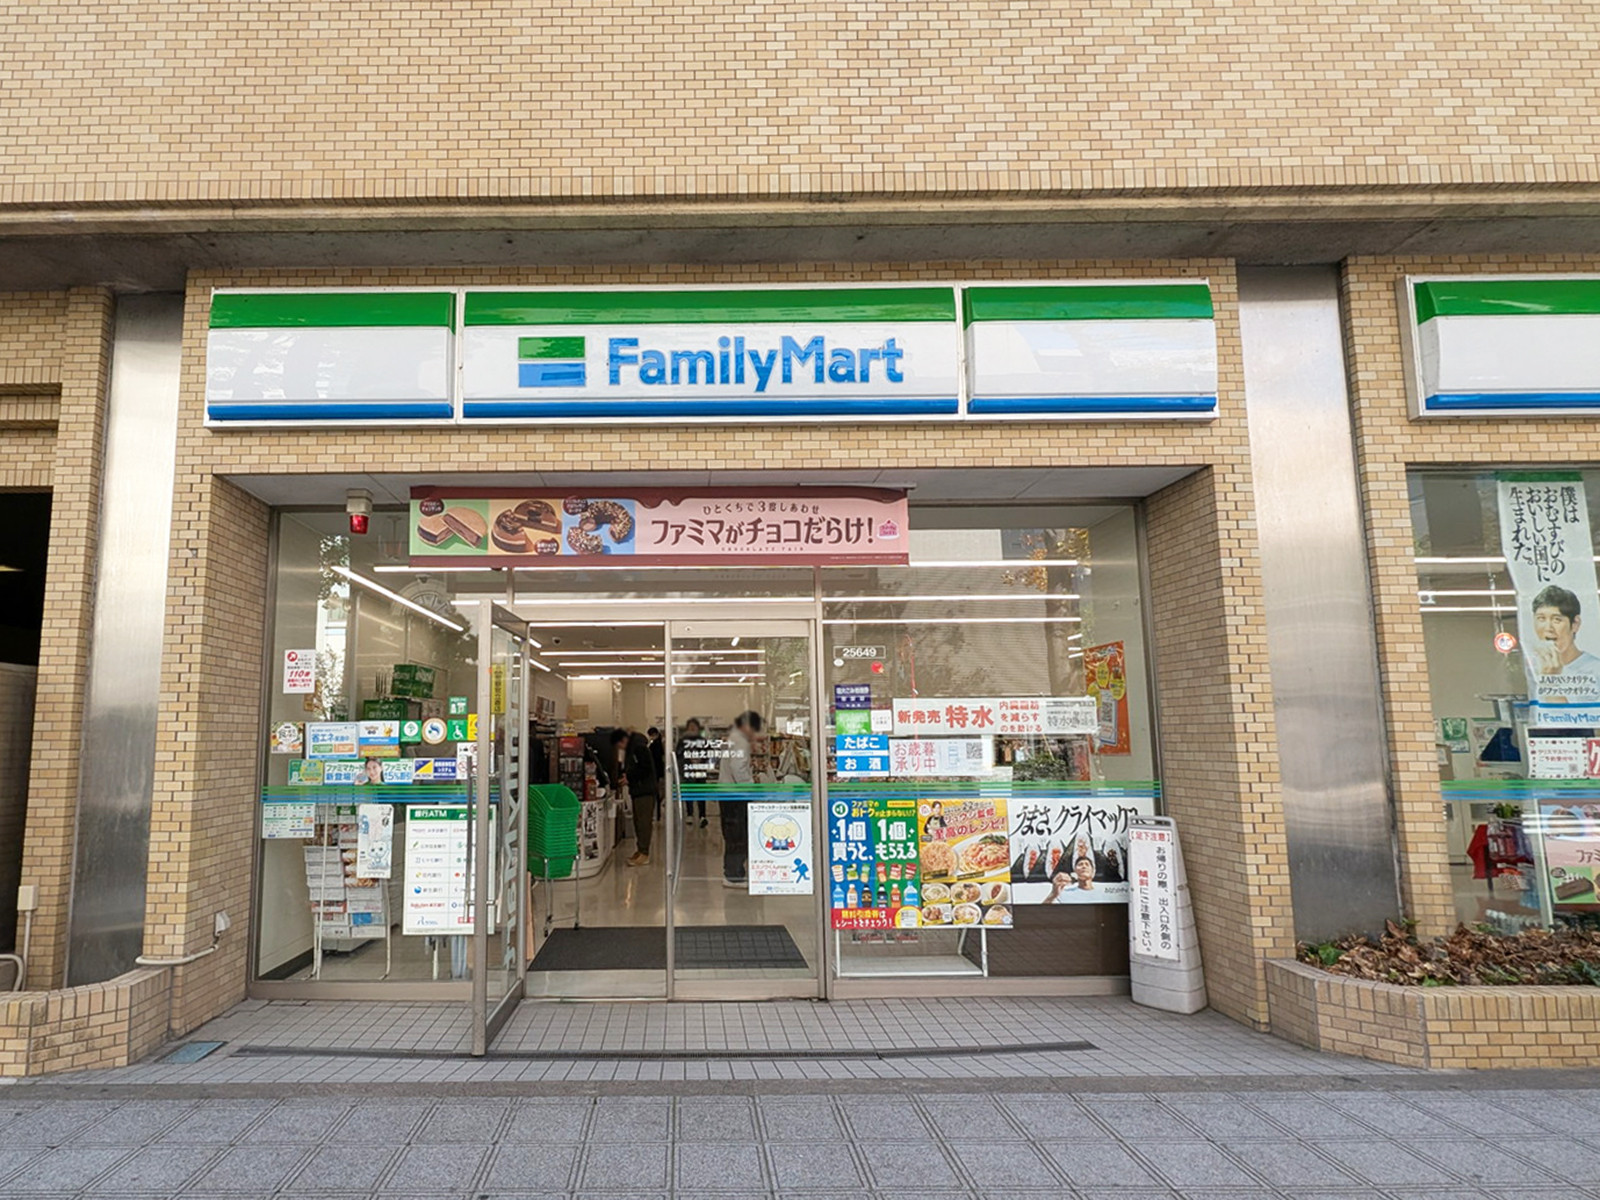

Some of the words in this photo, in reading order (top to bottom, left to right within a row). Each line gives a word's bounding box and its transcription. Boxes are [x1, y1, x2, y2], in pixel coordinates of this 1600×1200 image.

[608, 336, 903, 392] FamilyMart
[703, 500, 820, 515] ひとくちで3度しあわせ
[1560, 486, 1580, 523] 僕は
[1509, 486, 1534, 565] 生まれた。
[1526, 486, 1551, 582] おいしい国に
[1543, 486, 1565, 575] おむすびの
[842, 647, 877, 657] 25649
[897, 710, 941, 724] 新発売
[945, 705, 994, 728] 特水
[844, 736, 880, 749] たばこ
[894, 742, 936, 756] お歳暮
[895, 756, 937, 772] 承り中
[414, 809, 448, 818] 銀行ATM
[851, 800, 879, 808] ファミマの
[836, 819, 866, 841] 1個
[877, 819, 907, 841] 1個
[832, 842, 873, 861] 買うと、
[875, 842, 917, 861] もらえる
